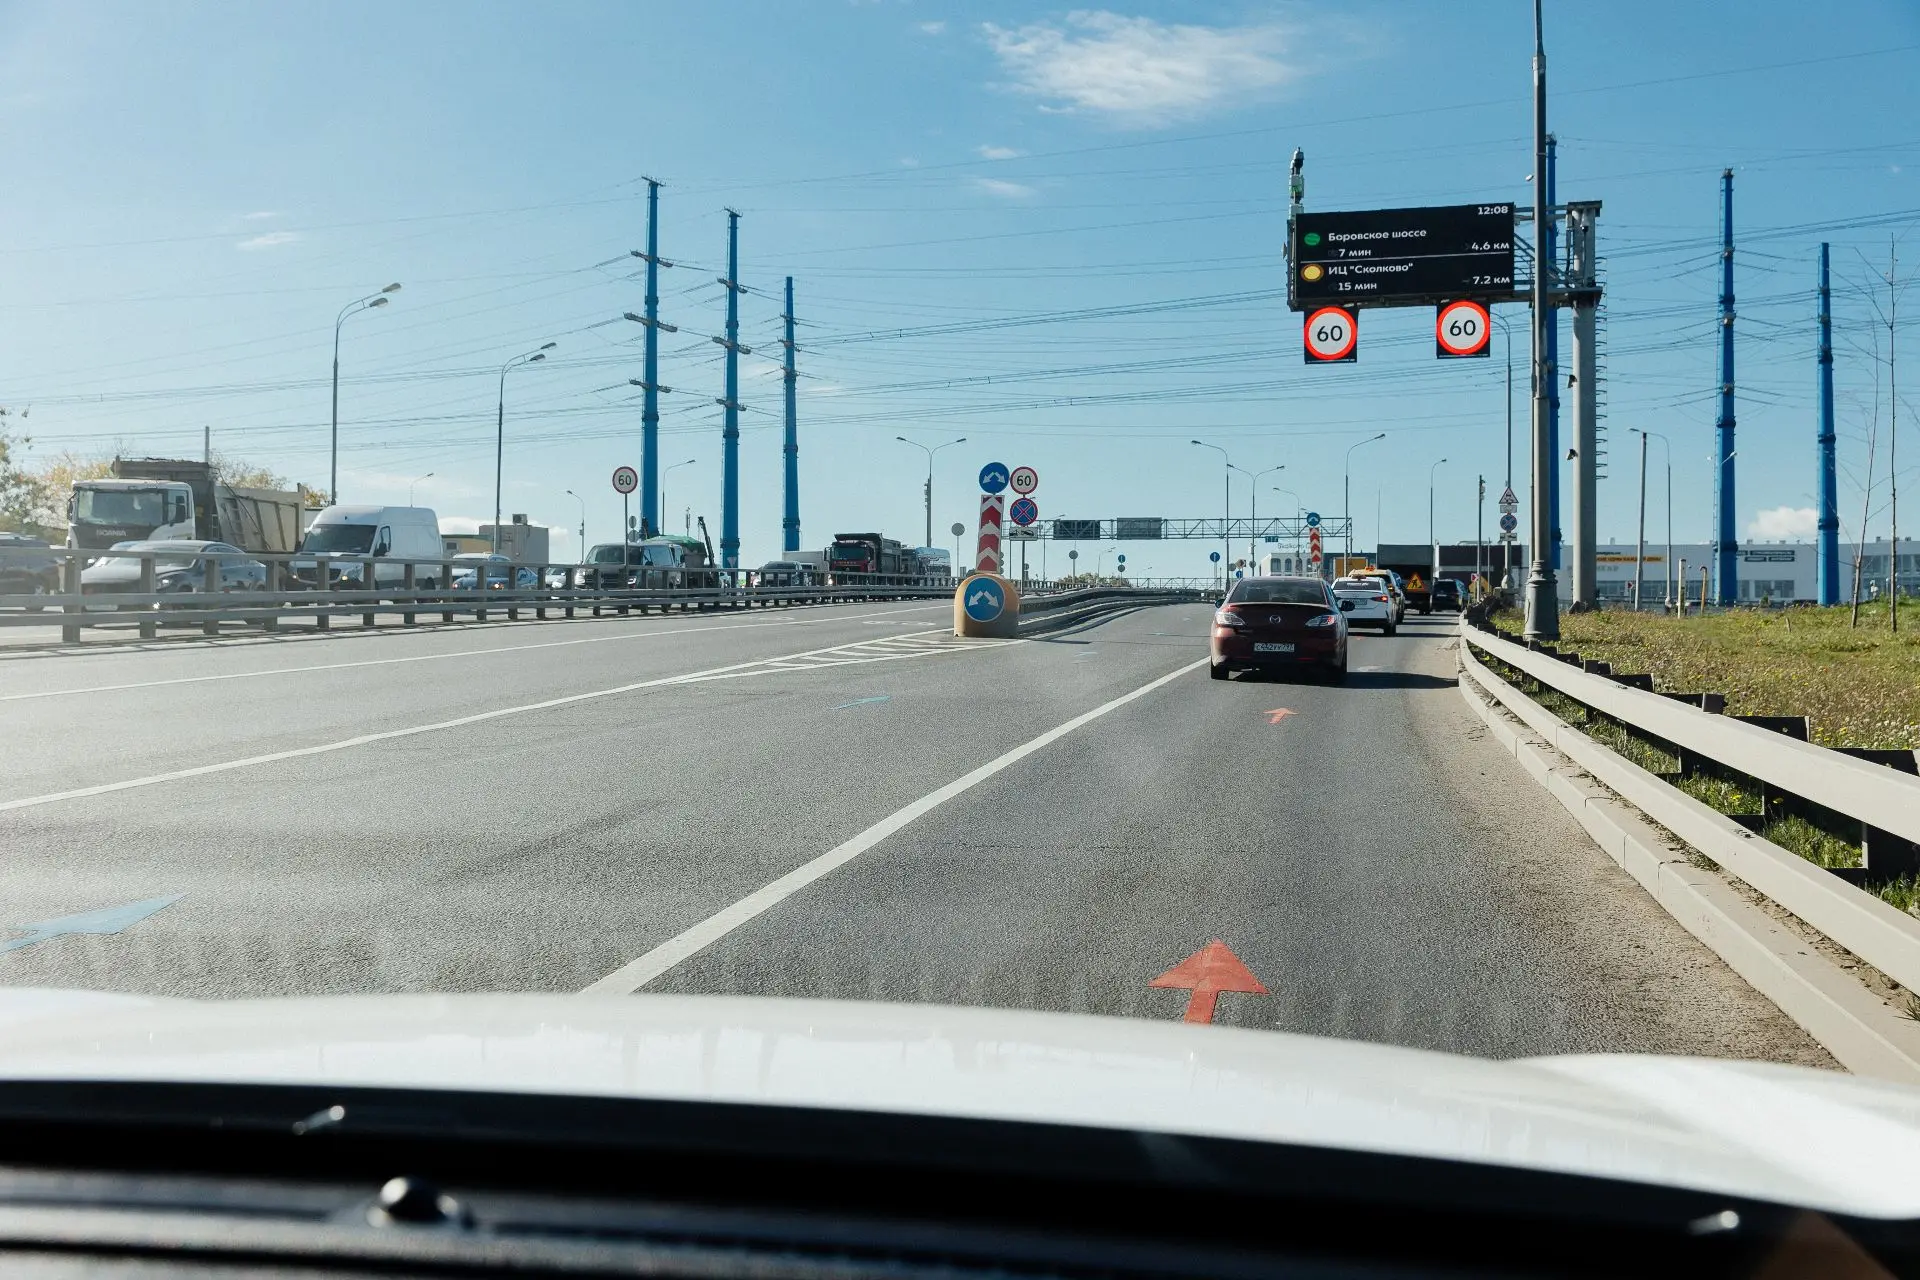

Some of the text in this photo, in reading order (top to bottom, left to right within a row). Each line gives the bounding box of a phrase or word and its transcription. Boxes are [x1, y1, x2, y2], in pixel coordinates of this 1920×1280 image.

[1477, 205, 1509, 215] 12:08
[1328, 229, 1427, 242] Боровское шоссе
[1471, 241, 1510, 251] 4.6 км
[1339, 248, 1372, 257] 7 мин
[1328, 263, 1414, 276] ИЦ "Сколково"
[1338, 282, 1377, 291] 15 мин
[1472, 276, 1511, 285] 7.2 км
[1316, 325, 1343, 342] 60
[1449, 319, 1477, 336] 60
[618, 474, 632, 486] 60
[1016, 475, 1032, 487] 60
